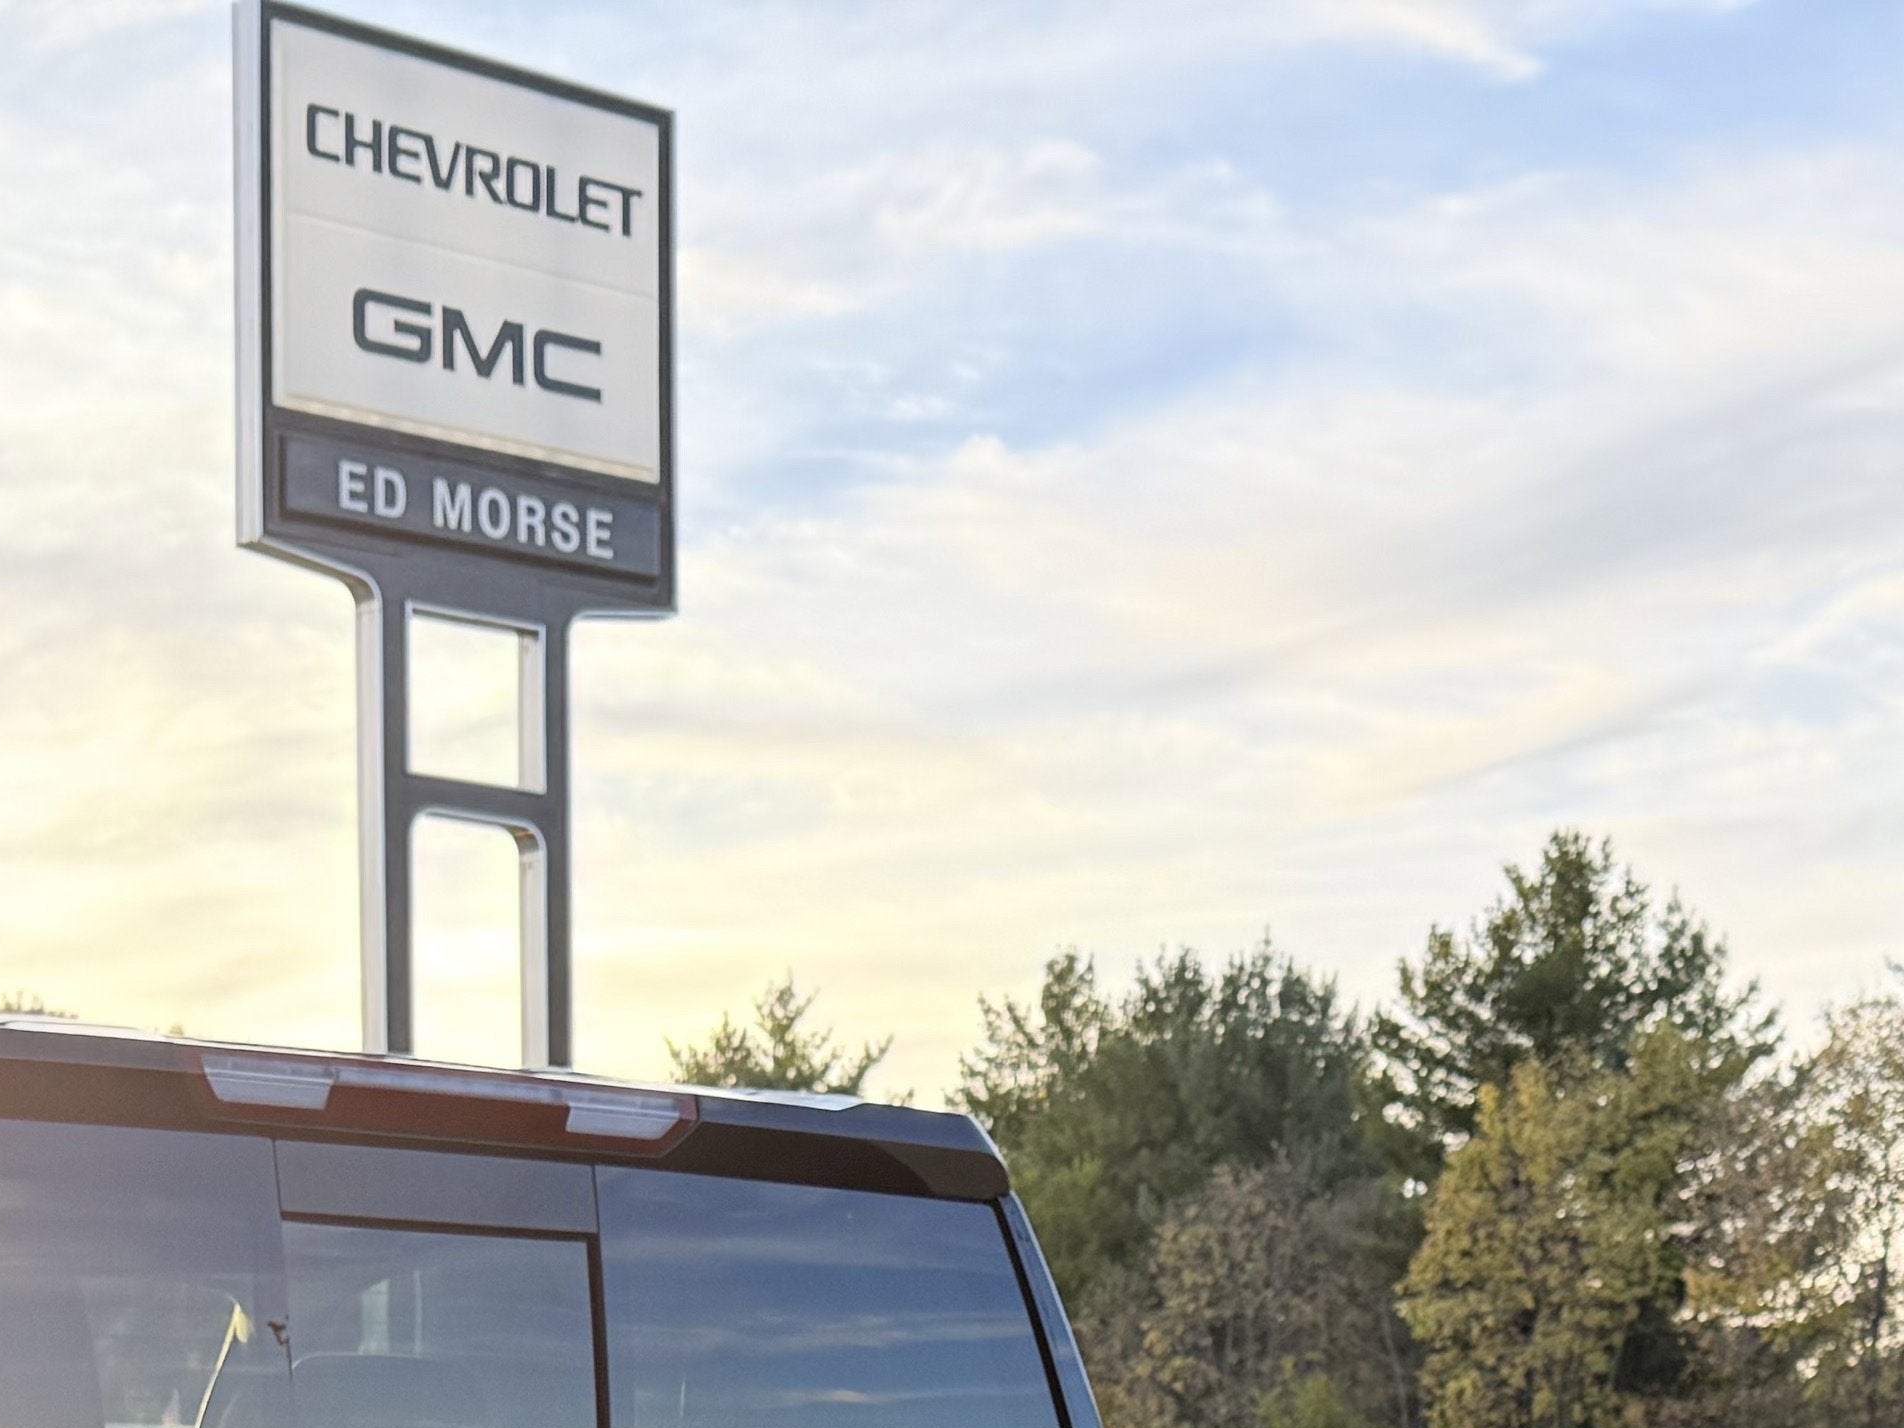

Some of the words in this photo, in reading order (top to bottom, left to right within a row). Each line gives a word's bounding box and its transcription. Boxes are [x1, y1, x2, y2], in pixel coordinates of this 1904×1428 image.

[305, 102, 643, 238] CHEVROLET
[352, 287, 602, 404] GMC
[337, 459, 407, 517] ED
[432, 476, 615, 560] MORSE
